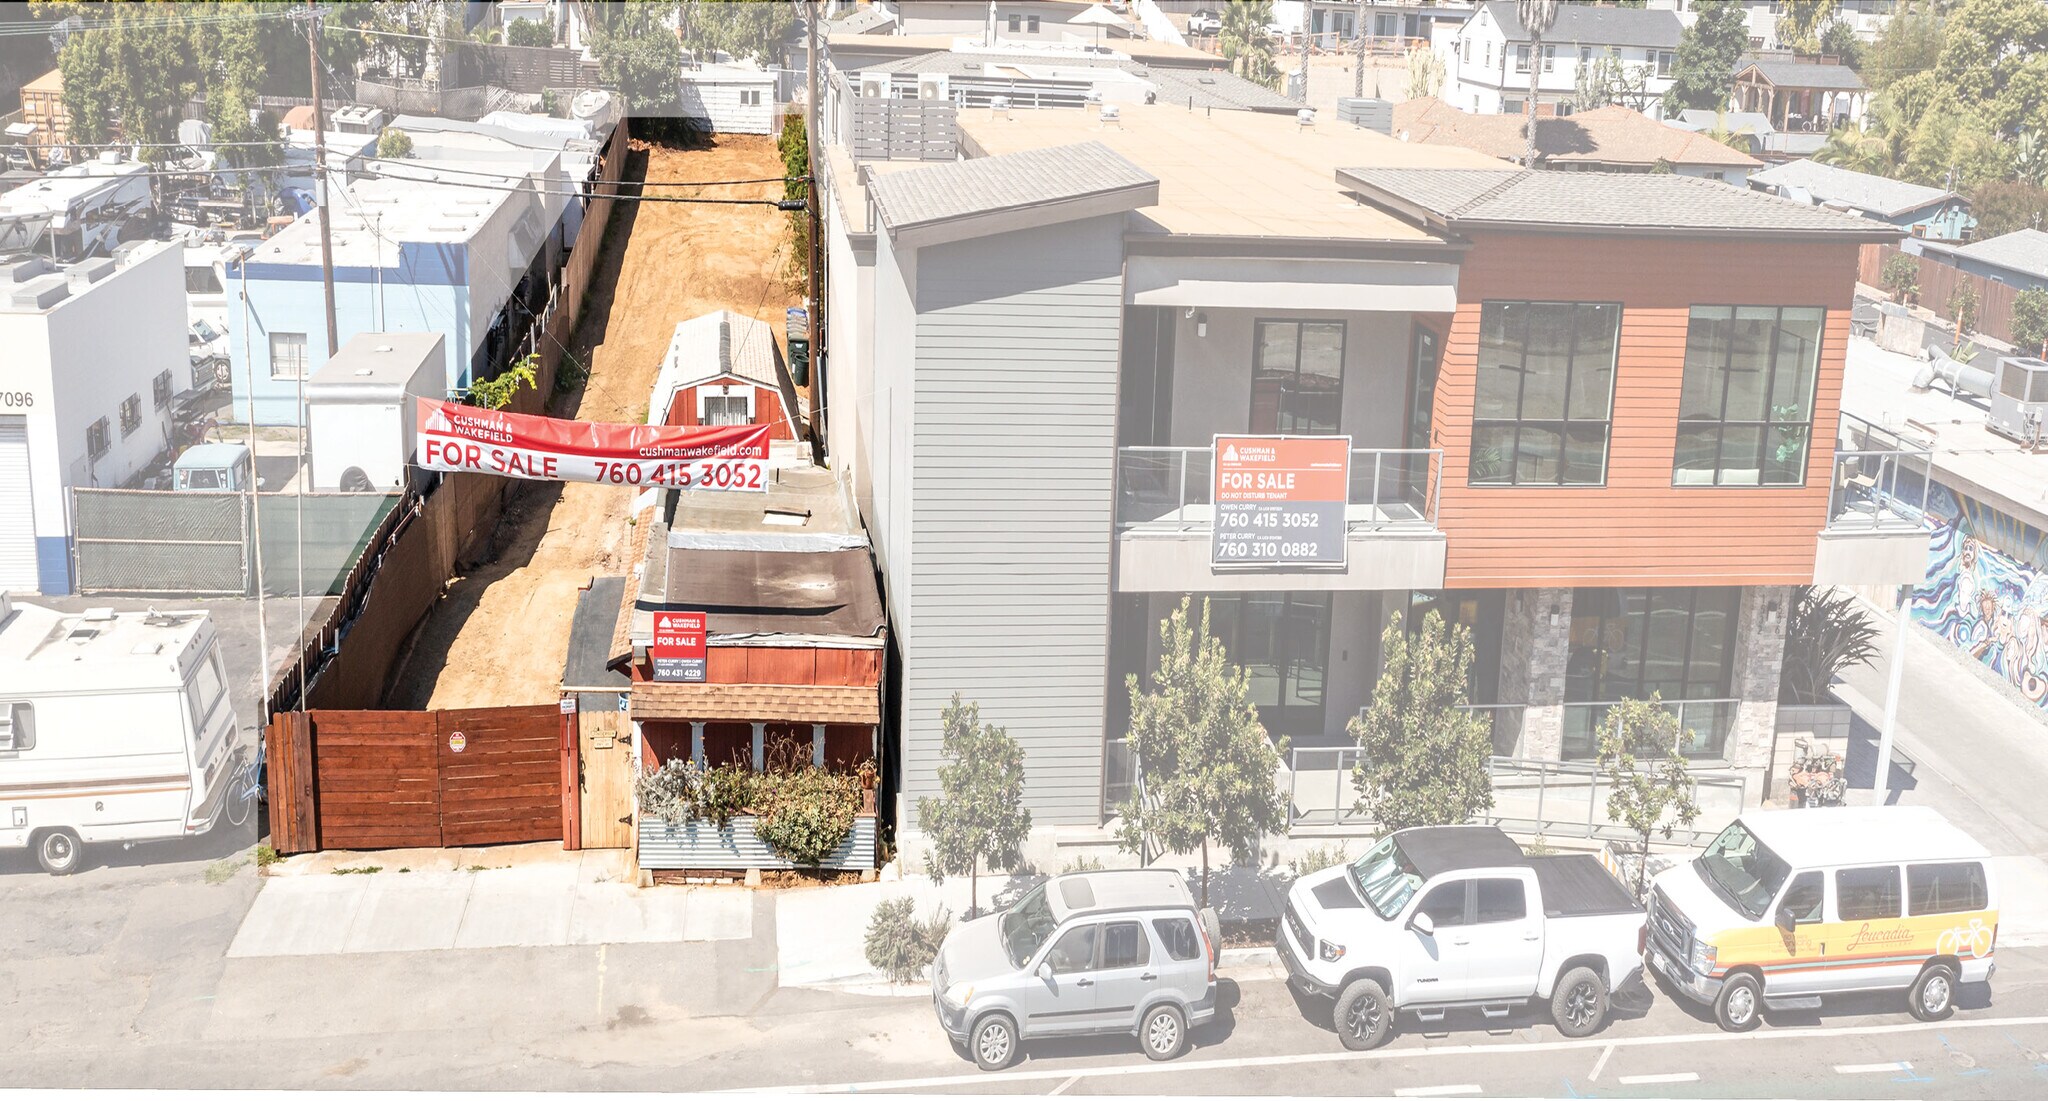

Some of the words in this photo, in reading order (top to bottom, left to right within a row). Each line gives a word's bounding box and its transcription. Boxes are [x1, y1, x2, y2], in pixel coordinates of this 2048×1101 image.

[453, 413, 504, 432] CUSHMAN
[505, 423, 513, 433] &
[454, 425, 514, 443] WAKEFIELD
[639, 443, 763, 458] cushmanwakefield.com
[1240, 447, 1271, 455] CUSHMAN
[1240, 454, 1276, 462] WAKEFIELD
[425, 439, 482, 471] FOR
[491, 449, 559, 479] SALE
[594, 460, 642, 485] 760
[650, 462, 692, 487] 415
[700, 463, 761, 489] 3052
[1221, 472, 1253, 489] FOR
[1257, 473, 1296, 489] SALE
[1220, 503, 1238, 511] OWEN
[1238, 503, 1257, 511] CURRY
[1220, 512, 1249, 527] 760
[1253, 512, 1278, 527] 415
[1282, 512, 1319, 528] 3052
[1219, 532, 1237, 540] PETER
[1237, 532, 1256, 540] CURRY
[1219, 542, 1248, 557] 760
[1252, 542, 1277, 557] 310
[1281, 542, 1318, 557] 0882
[657, 636, 674, 646] FOR
[675, 637, 696, 646] SALE
[657, 669, 671, 677] 760
[671, 669, 683, 677] 431
[684, 669, 702, 677] 4229
